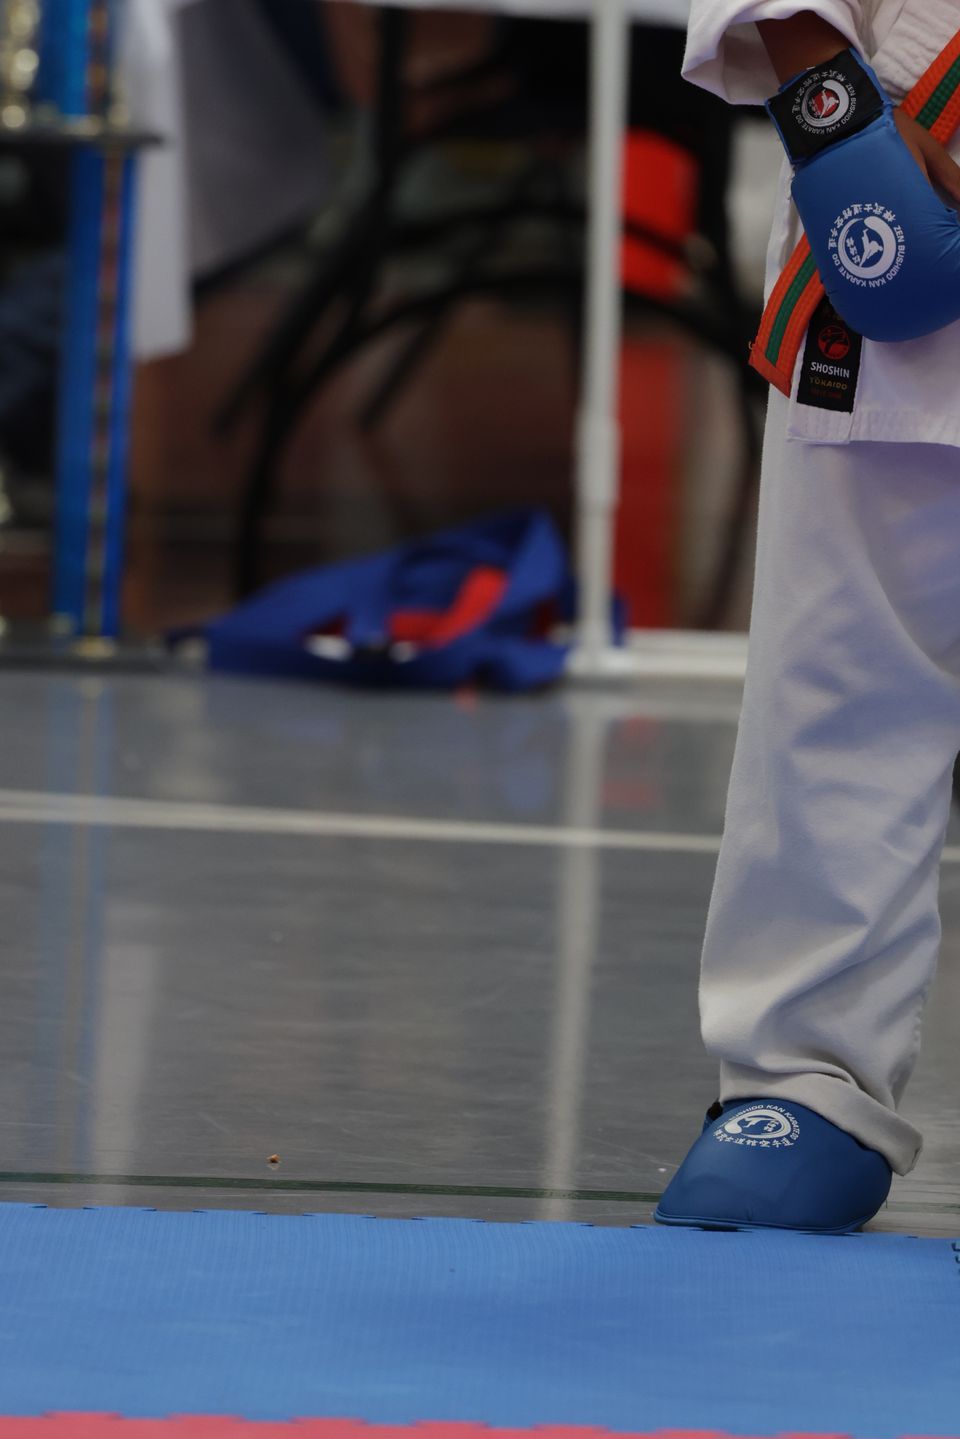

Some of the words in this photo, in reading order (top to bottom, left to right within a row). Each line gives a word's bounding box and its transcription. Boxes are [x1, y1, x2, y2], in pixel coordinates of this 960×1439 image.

[845, 83, 857, 98] ZEN
[842, 98, 857, 125] BUSHIDO
[795, 115, 804, 125] DO
[801, 123, 826, 135] KARATE
[826, 123, 842, 135] KAN
[894, 225, 905, 243] ZEN
[831, 253, 841, 266] DO
[886, 245, 906, 281] BUSHIDO
[838, 266, 867, 288] KARATE
[868, 279, 886, 288] KAN
[810, 361, 850, 378] SHOSHIN
[809, 377, 849, 390] TOKAIDO
[766, 1104, 786, 1113] KAN
